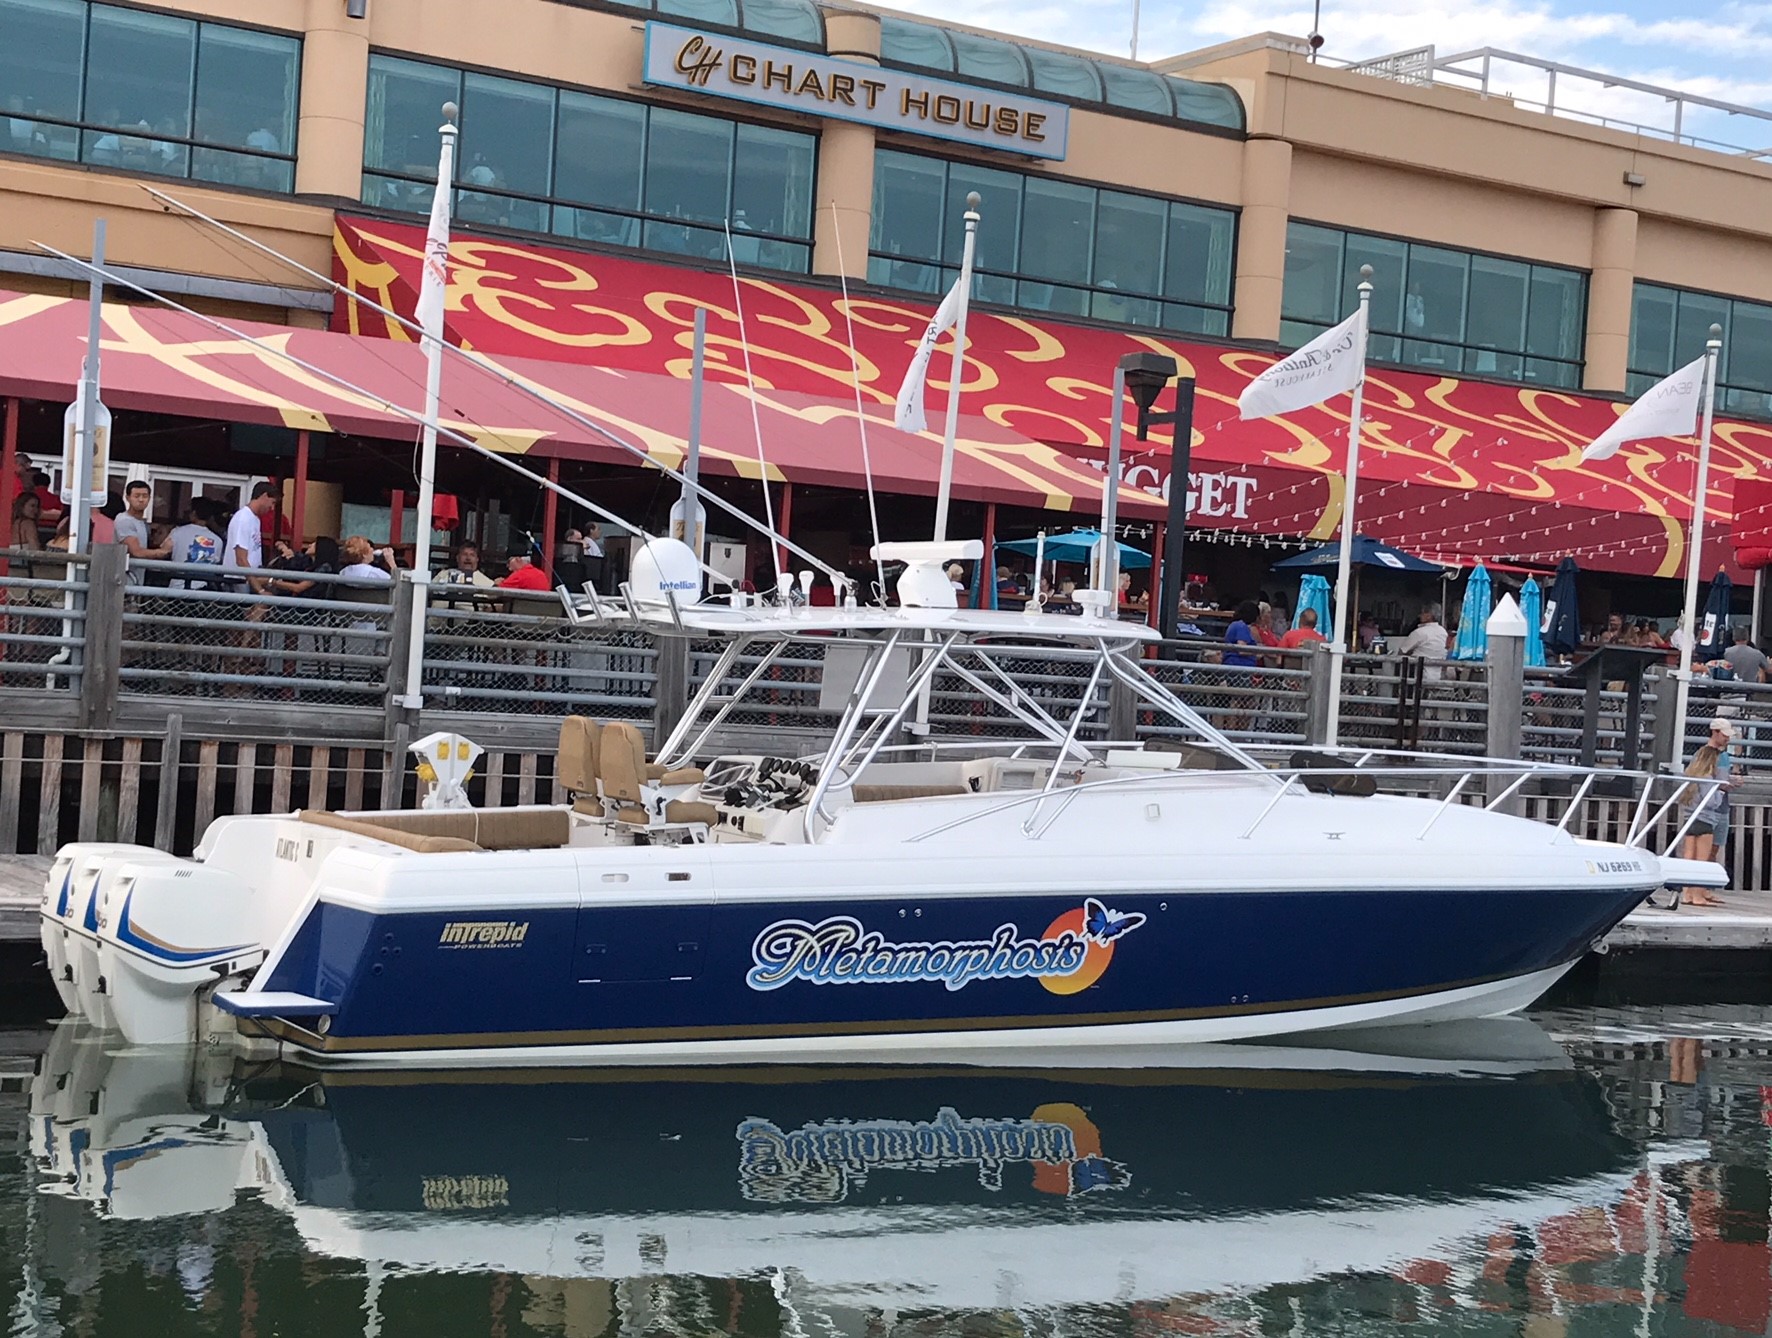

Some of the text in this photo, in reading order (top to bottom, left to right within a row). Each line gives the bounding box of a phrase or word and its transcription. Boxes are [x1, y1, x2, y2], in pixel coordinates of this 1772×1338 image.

[729, 54, 887, 110] CHART
[900, 87, 1048, 142] HOUSE
[1077, 457, 1258, 519] GGET
[659, 581, 697, 590] Intellian
[1597, 861, 1609, 872] NJ
[749, 919, 1086, 988] Metamorphosis
